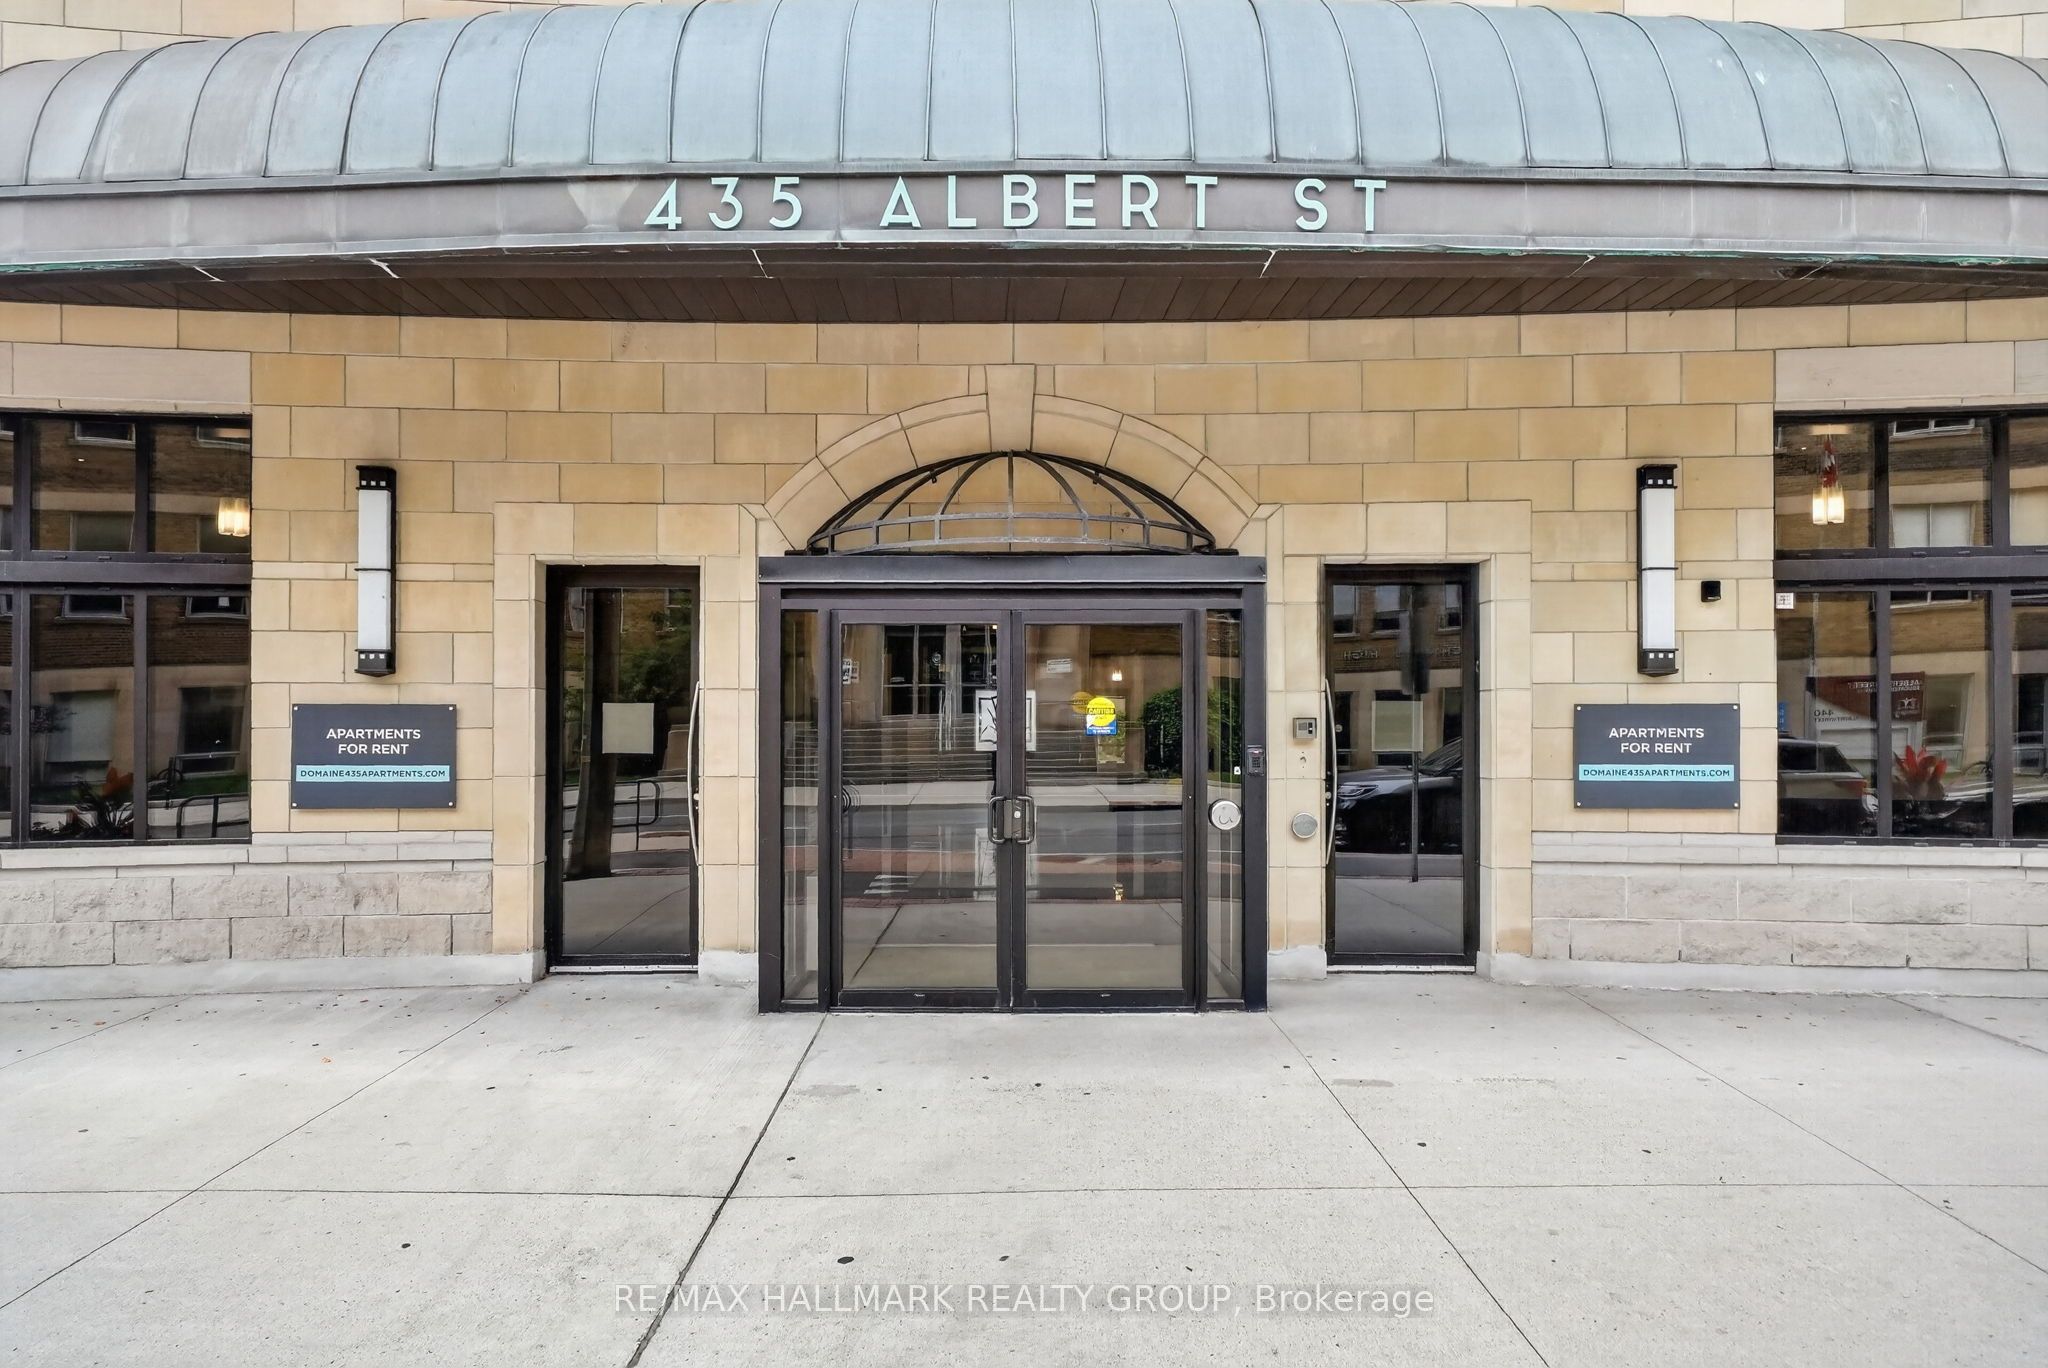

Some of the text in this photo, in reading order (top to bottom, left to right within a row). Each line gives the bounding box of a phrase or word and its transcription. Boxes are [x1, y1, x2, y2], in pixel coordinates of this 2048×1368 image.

[644, 174, 1387, 232] 435 ALBERT ST
[326, 728, 421, 739] APARTMENTS
[1608, 727, 1705, 739] APARTMENTS
[338, 743, 409, 755] FOR RENT
[1620, 742, 1692, 754] FOR RENT
[300, 769, 446, 778] DOMAINE435APARTMENTS.COM
[1583, 768, 1731, 778] DOMAINE435APARTMENTS.COM
